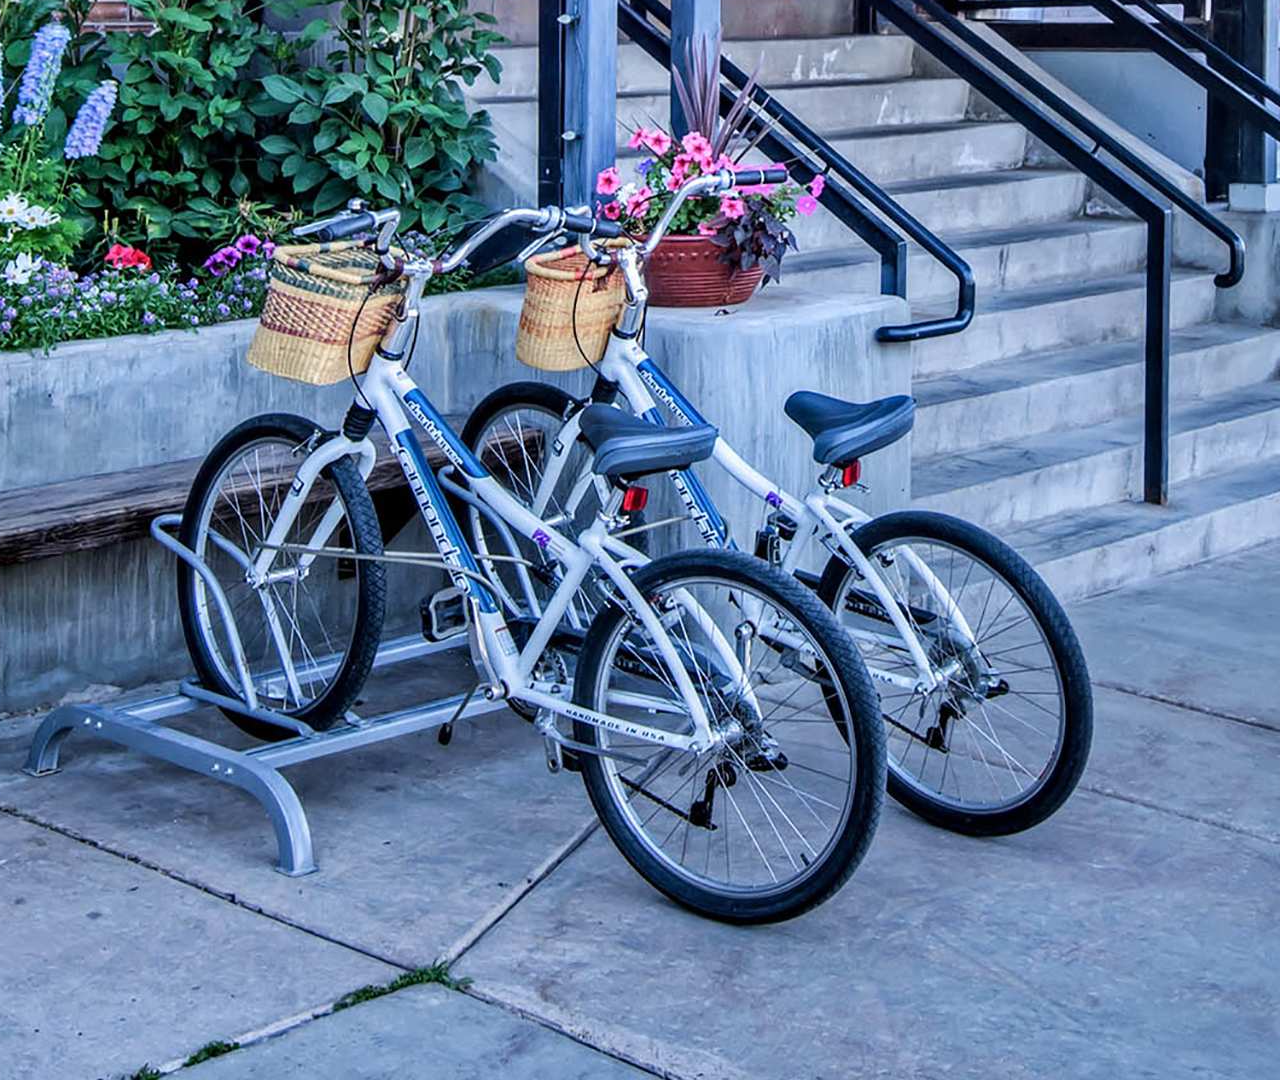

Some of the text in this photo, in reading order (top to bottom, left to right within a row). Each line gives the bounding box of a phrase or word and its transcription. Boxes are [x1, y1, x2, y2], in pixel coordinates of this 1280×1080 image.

[565, 708, 665, 742] HANDMADE IN USA
